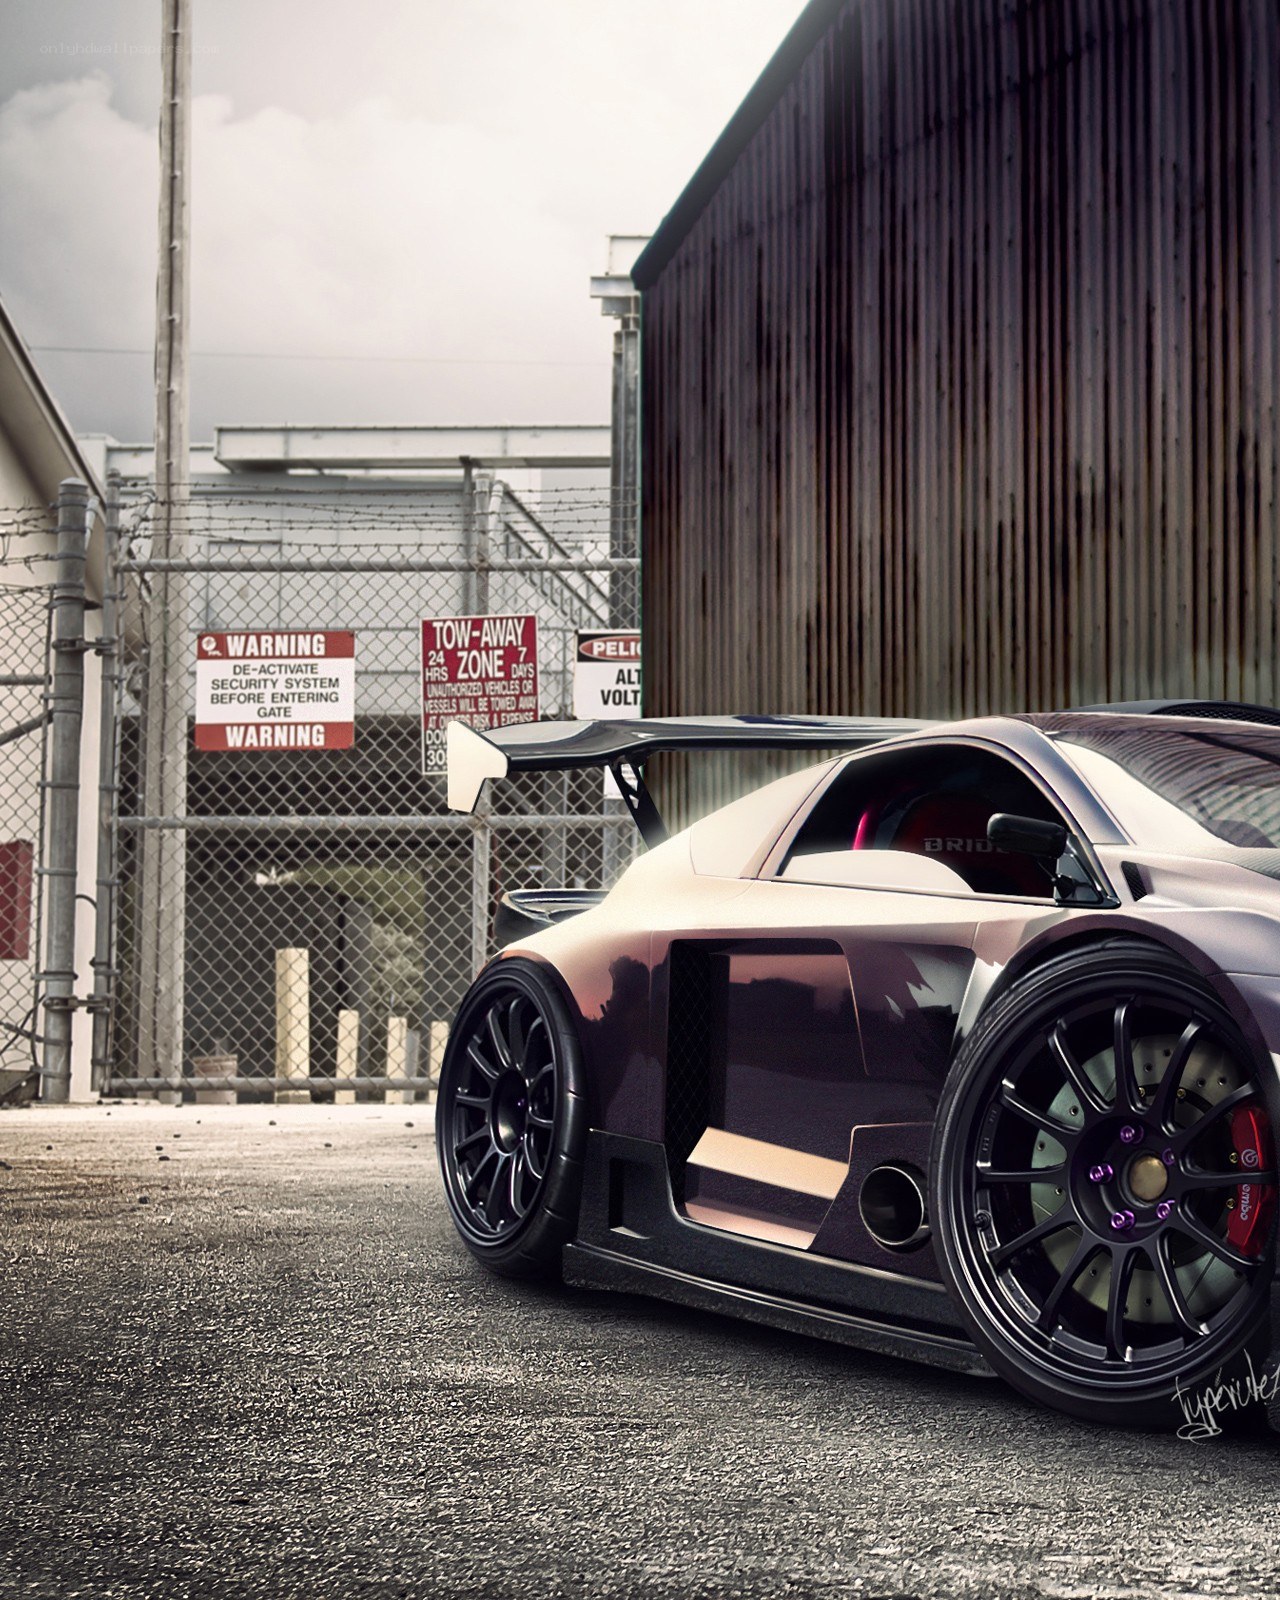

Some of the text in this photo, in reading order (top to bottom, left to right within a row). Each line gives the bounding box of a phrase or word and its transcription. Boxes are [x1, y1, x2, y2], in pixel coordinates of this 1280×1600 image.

[432, 618, 525, 649] TOW-AWAY
[226, 634, 326, 657] WARNING
[428, 650, 445, 666] 24
[518, 647, 527, 662] 7
[233, 663, 319, 675] DE-ACTIVATE
[457, 650, 505, 679] ZONE
[511, 662, 534, 678] DAYS
[425, 667, 448, 682] HRS
[211, 677, 339, 690] SECURITY SYSTEM
[427, 680, 533, 698] UNAUTHORIZED VEHICLES OR
[211, 692, 339, 704] BEFORE ENTERING
[424, 696, 537, 713] VESSELS WILL BE TOWED AWAY
[601, 689, 641, 706] VOLT
[257, 707, 292, 718] GATE
[428, 716, 437, 729] AT
[473, 714, 491, 728] RISK
[225, 724, 325, 748] WARNING
[427, 749, 448, 765] 30
[924, 838, 1009, 853] BRID
